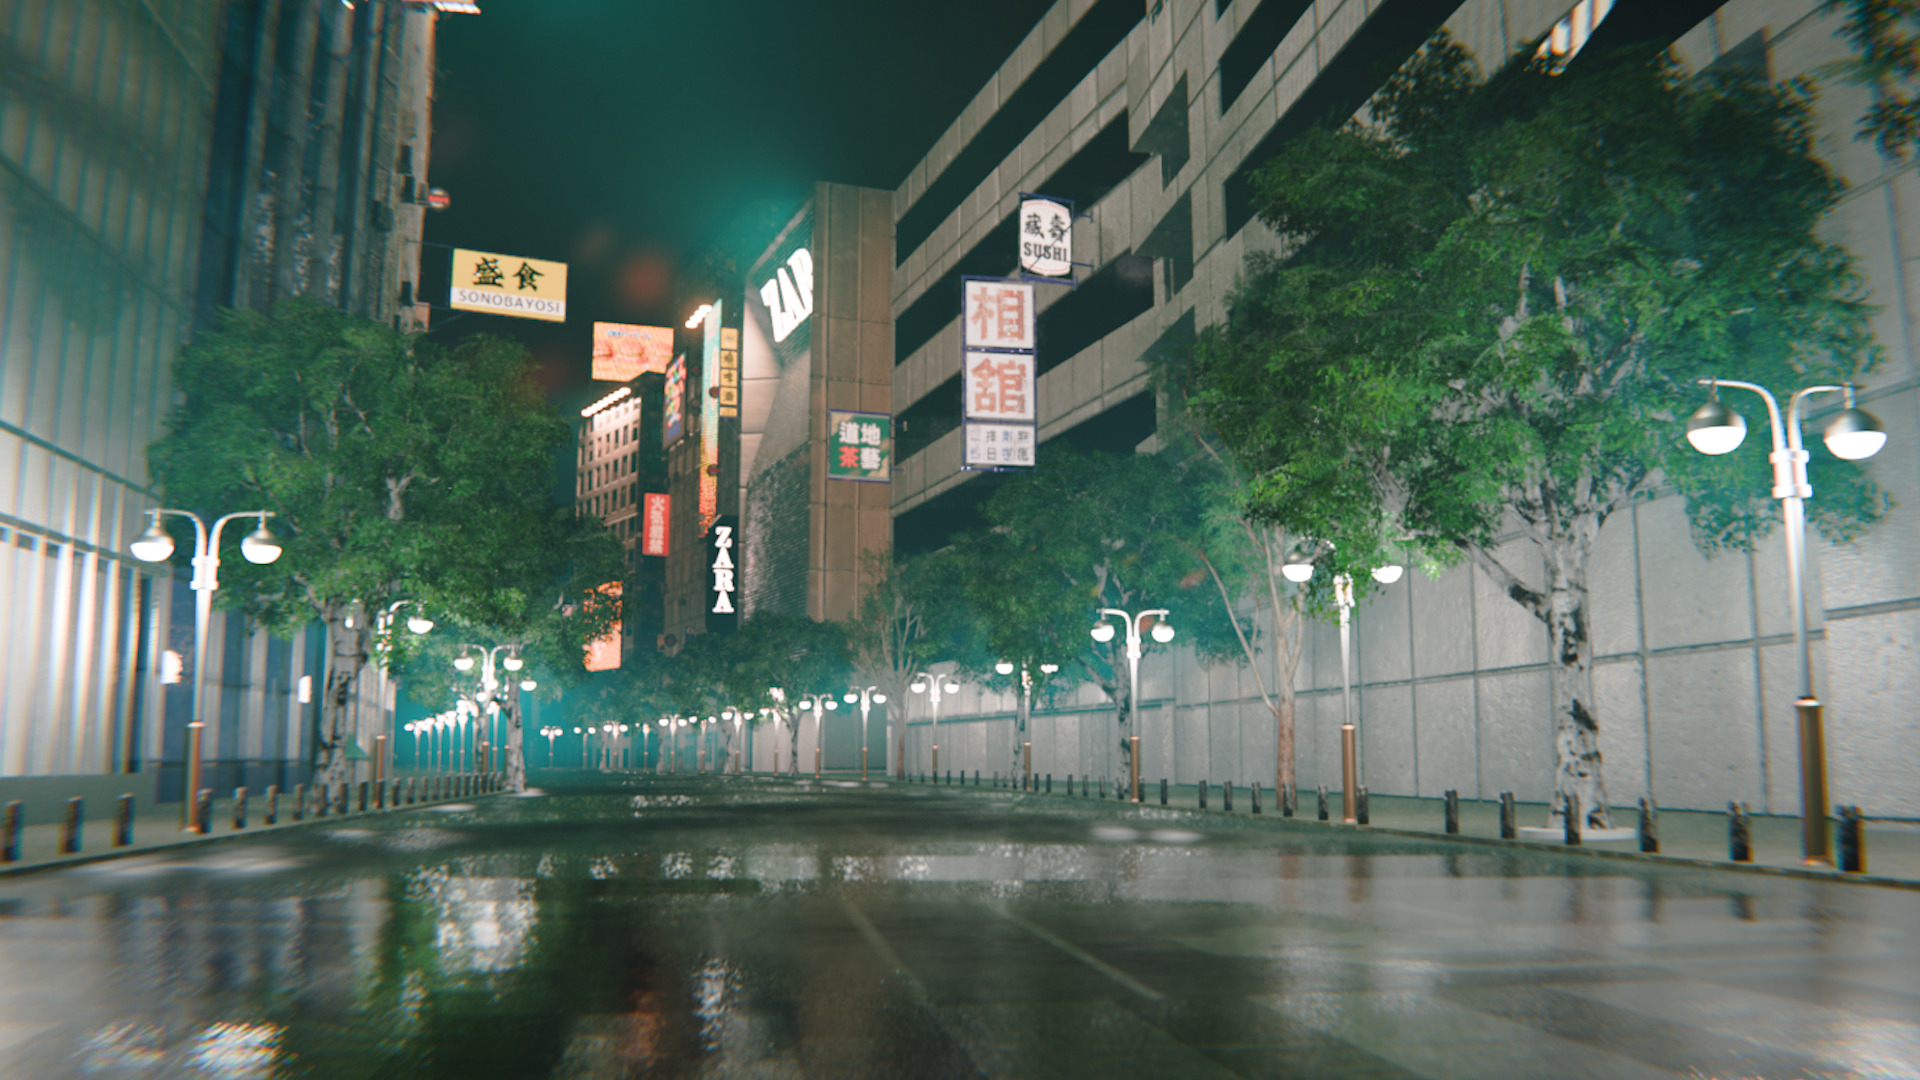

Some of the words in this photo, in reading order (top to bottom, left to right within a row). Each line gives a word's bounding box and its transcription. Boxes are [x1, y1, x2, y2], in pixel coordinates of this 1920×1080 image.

[1023, 242, 1067, 262] SUSHI
[472, 256, 545, 292] 盛食
[458, 289, 560, 313] SONOBAYOSI
[712, 526, 734, 614] ZARA
